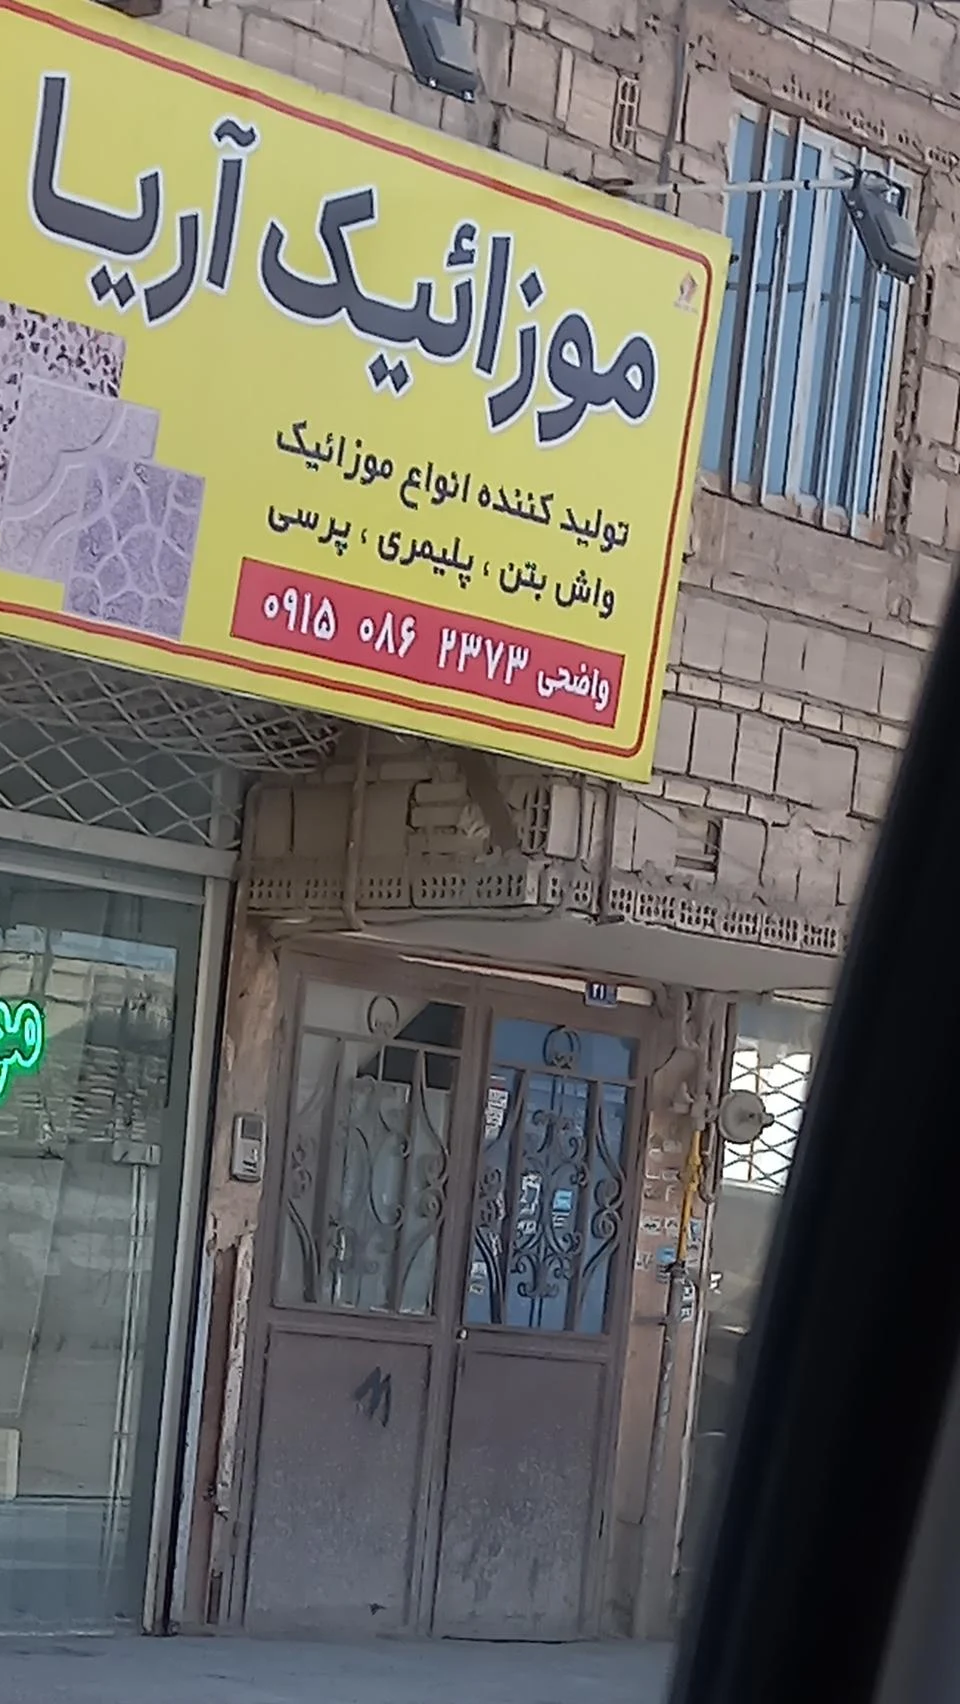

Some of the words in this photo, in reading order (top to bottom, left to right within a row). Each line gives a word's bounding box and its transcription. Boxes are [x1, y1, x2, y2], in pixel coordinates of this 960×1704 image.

[30, 73, 258, 325] آریا
[260, 188, 659, 446] موزائیک
[276, 420, 394, 485] موزائیک
[399, 462, 471, 510] انواع
[478, 483, 555, 525] کننده
[267, 504, 351, 556] پرسی
[560, 507, 630, 552] تولید
[378, 530, 474, 588] پلیمری
[499, 559, 548, 601] بتن
[262, 586, 337, 641] ۰۹۱۵
[555, 570, 615, 619] واش
[358, 611, 418, 658] ۰۸۶
[438, 627, 531, 685] ۲۳۷۳
[537, 662, 611, 711] واضحی
